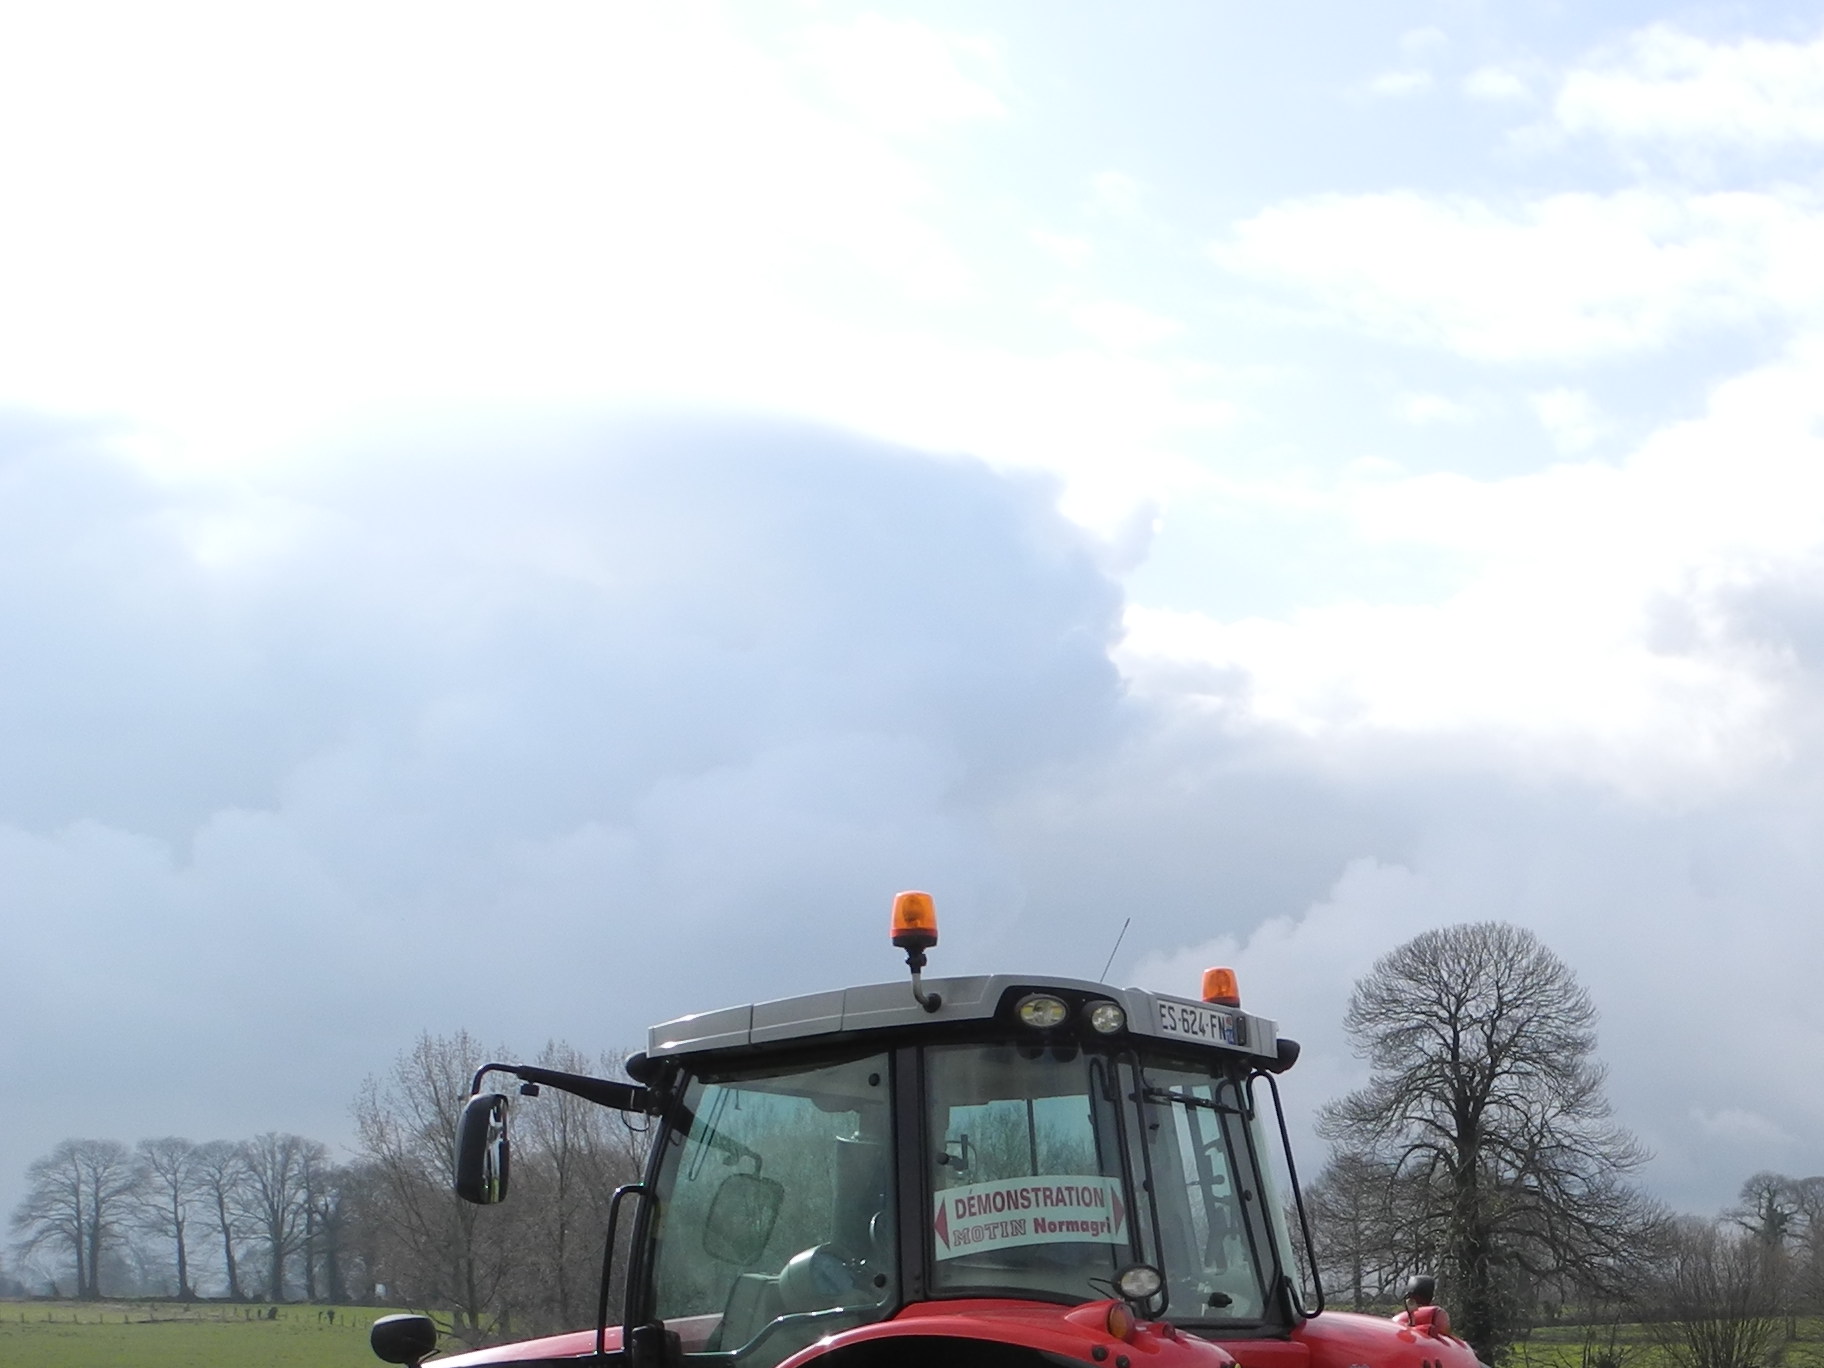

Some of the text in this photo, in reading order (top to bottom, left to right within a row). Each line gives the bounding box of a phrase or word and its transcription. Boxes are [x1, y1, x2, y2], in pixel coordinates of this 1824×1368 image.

[1159, 1003, 1227, 1041] ES-624-FN
[955, 1186, 1105, 1220] DÉMONSTRATION
[953, 1216, 1112, 1247] MOTIN Normagri
